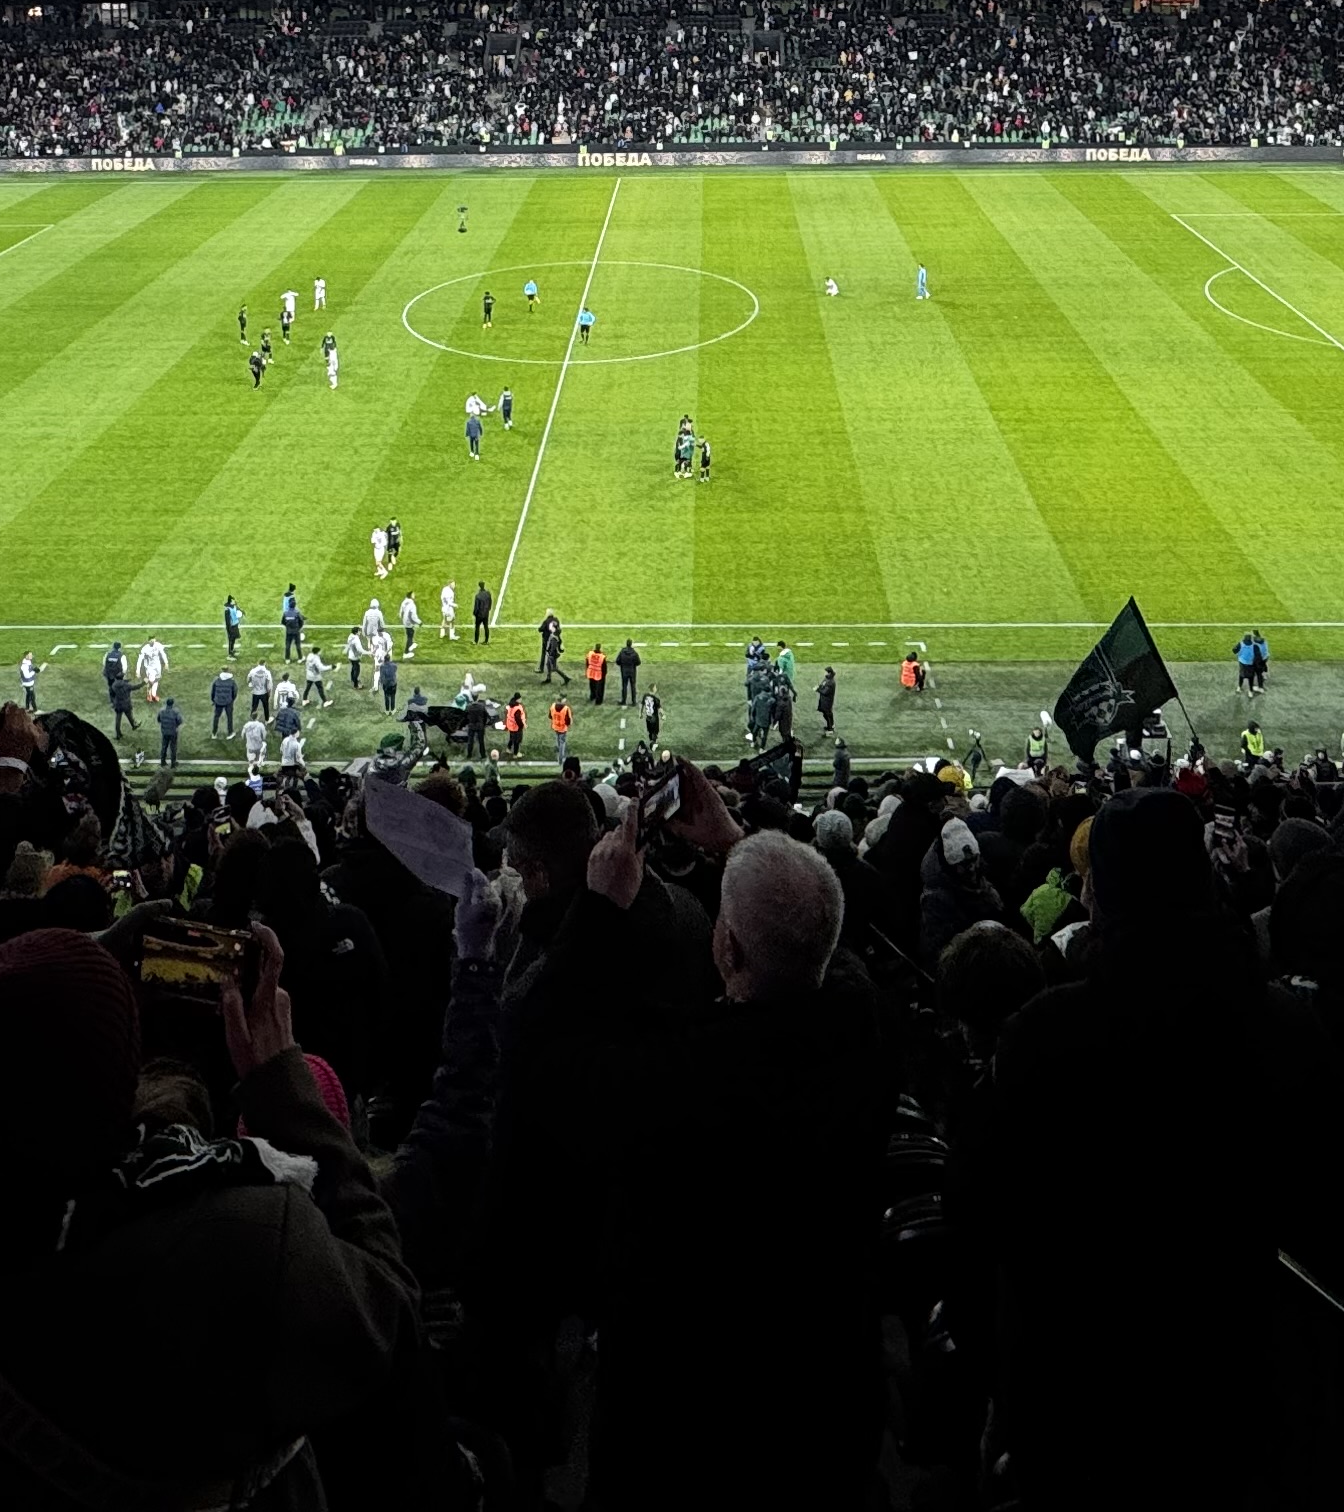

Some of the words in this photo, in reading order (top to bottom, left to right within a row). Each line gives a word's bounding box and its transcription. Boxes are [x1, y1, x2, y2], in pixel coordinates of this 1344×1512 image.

[578, 152, 652, 166] ПОБЕДА
[1086, 148, 1152, 162] ПОБЕДА
[91, 158, 155, 171] ПОБЕДА
